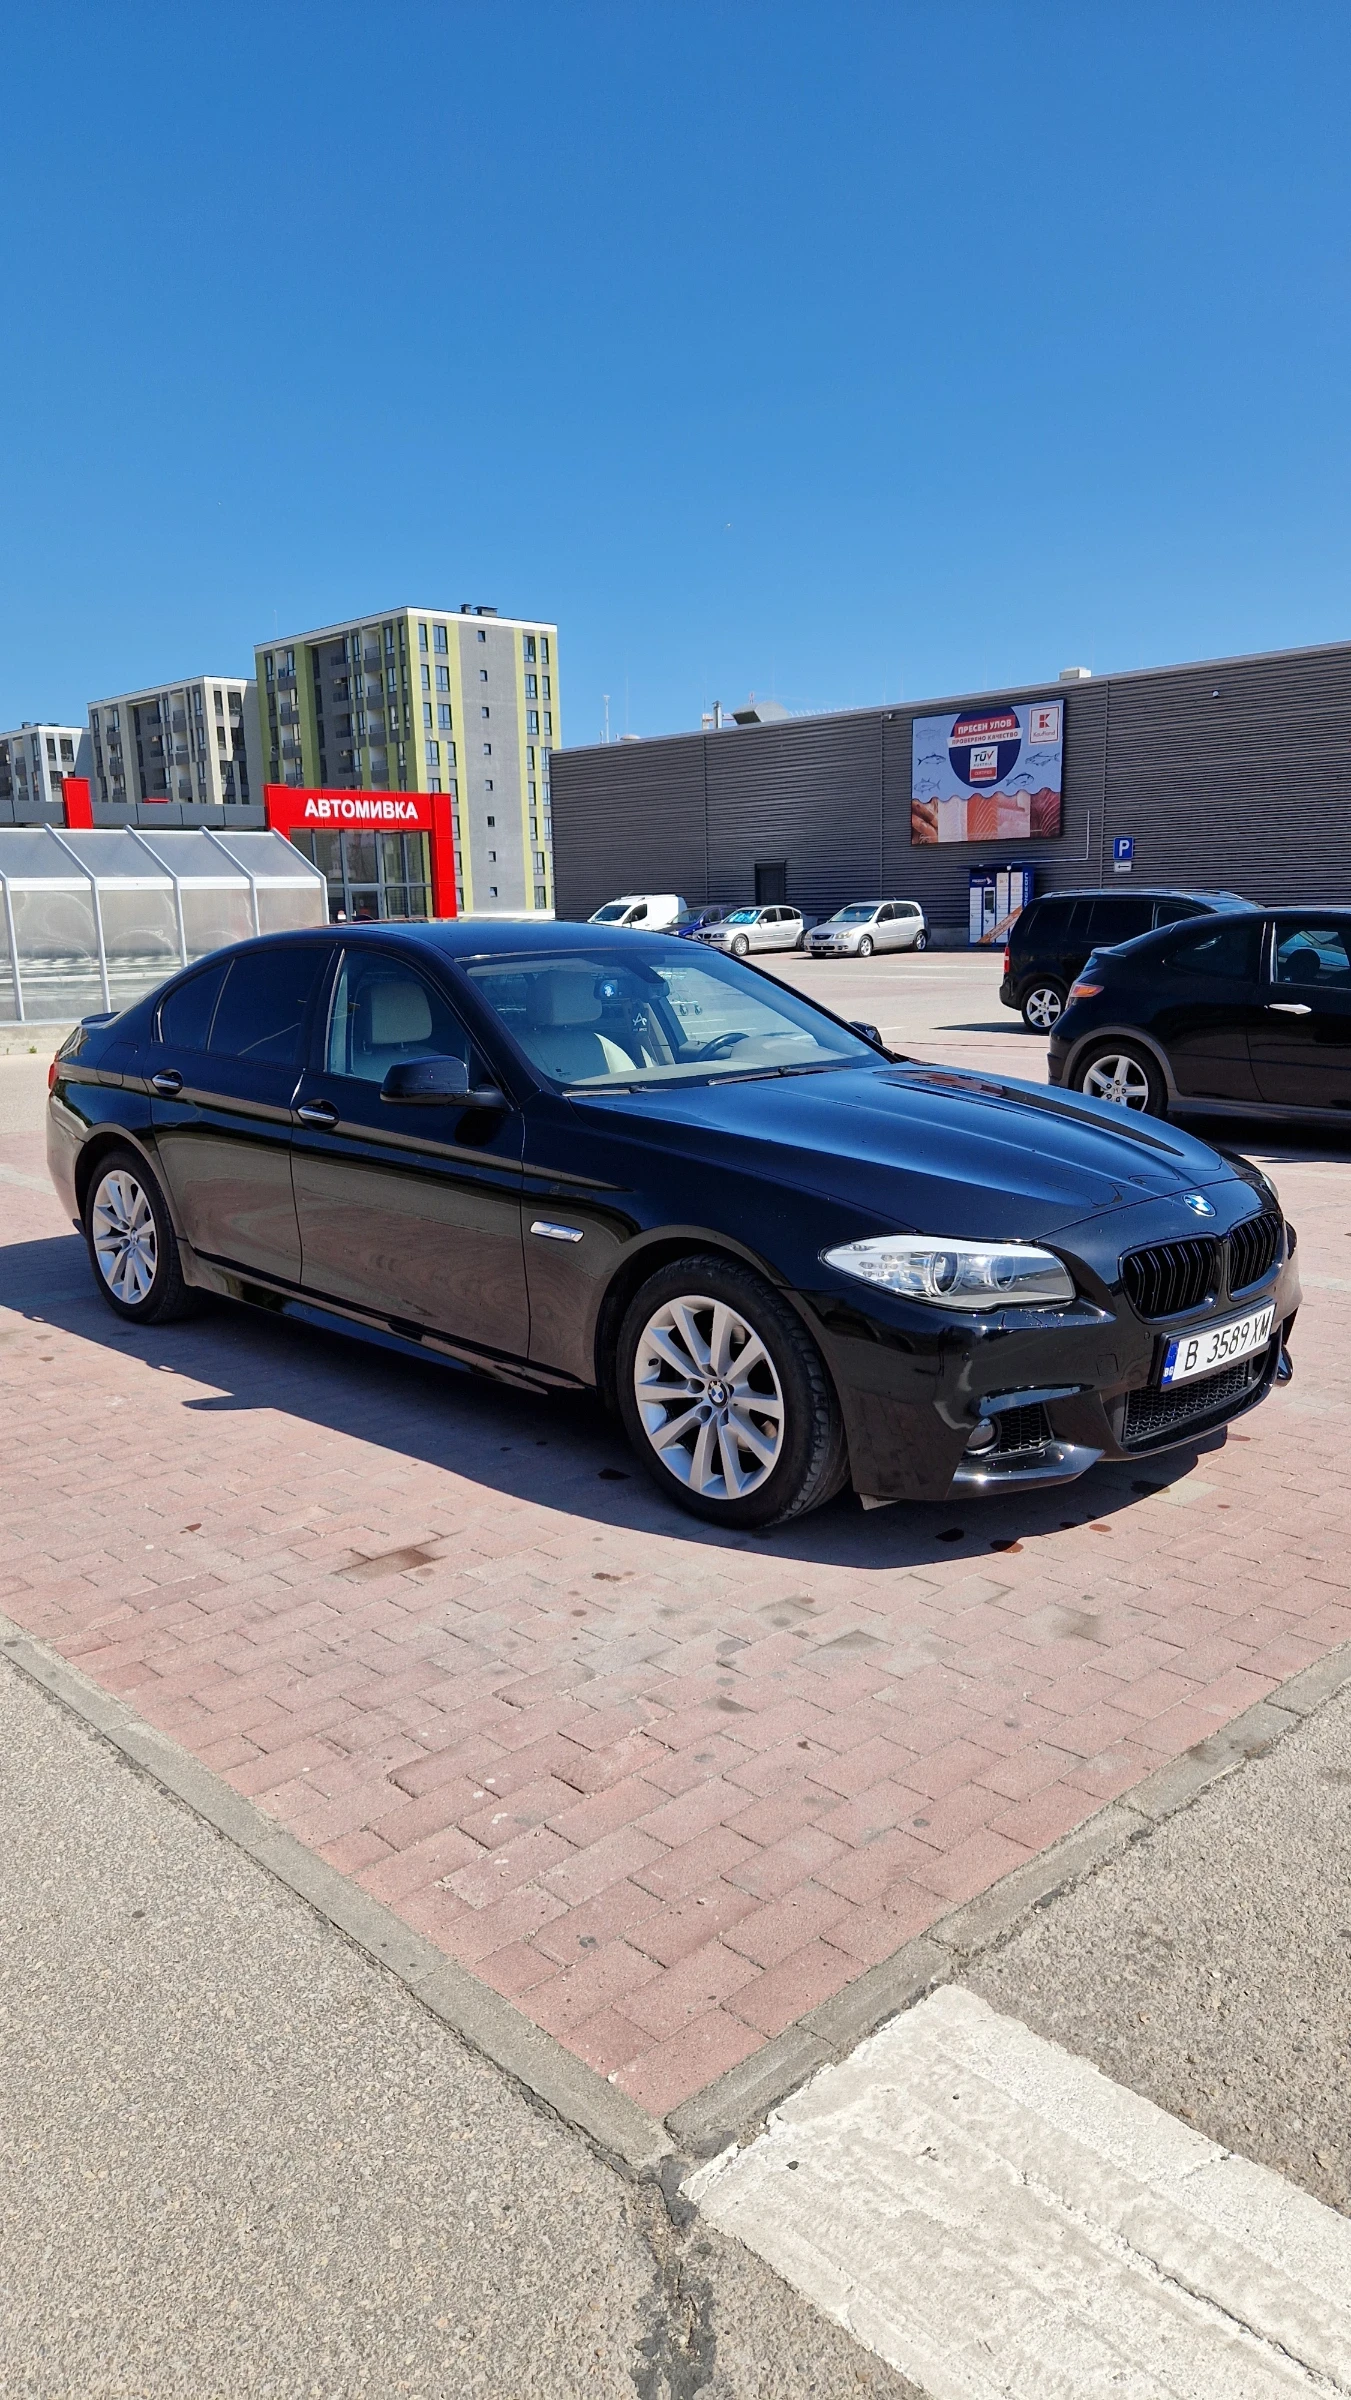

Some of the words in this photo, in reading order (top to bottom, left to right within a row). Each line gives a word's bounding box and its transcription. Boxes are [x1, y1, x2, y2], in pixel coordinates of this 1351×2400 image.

[958, 724, 988, 735] ПРЕСЕН
[990, 719, 1012, 730] УЛОВ
[952, 736, 986, 745] ПРОВЕРЕНО
[987, 731, 1018, 740] КАЧЕСТВО
[304, 798, 418, 819] АВТОМИВКА
[1119, 840, 1130, 857] P
[1184, 1339, 1199, 1371] B
[1206, 1321, 1250, 1363] 3589
[1249, 1310, 1272, 1346] XM
[1163, 1366, 1175, 1377] BG
